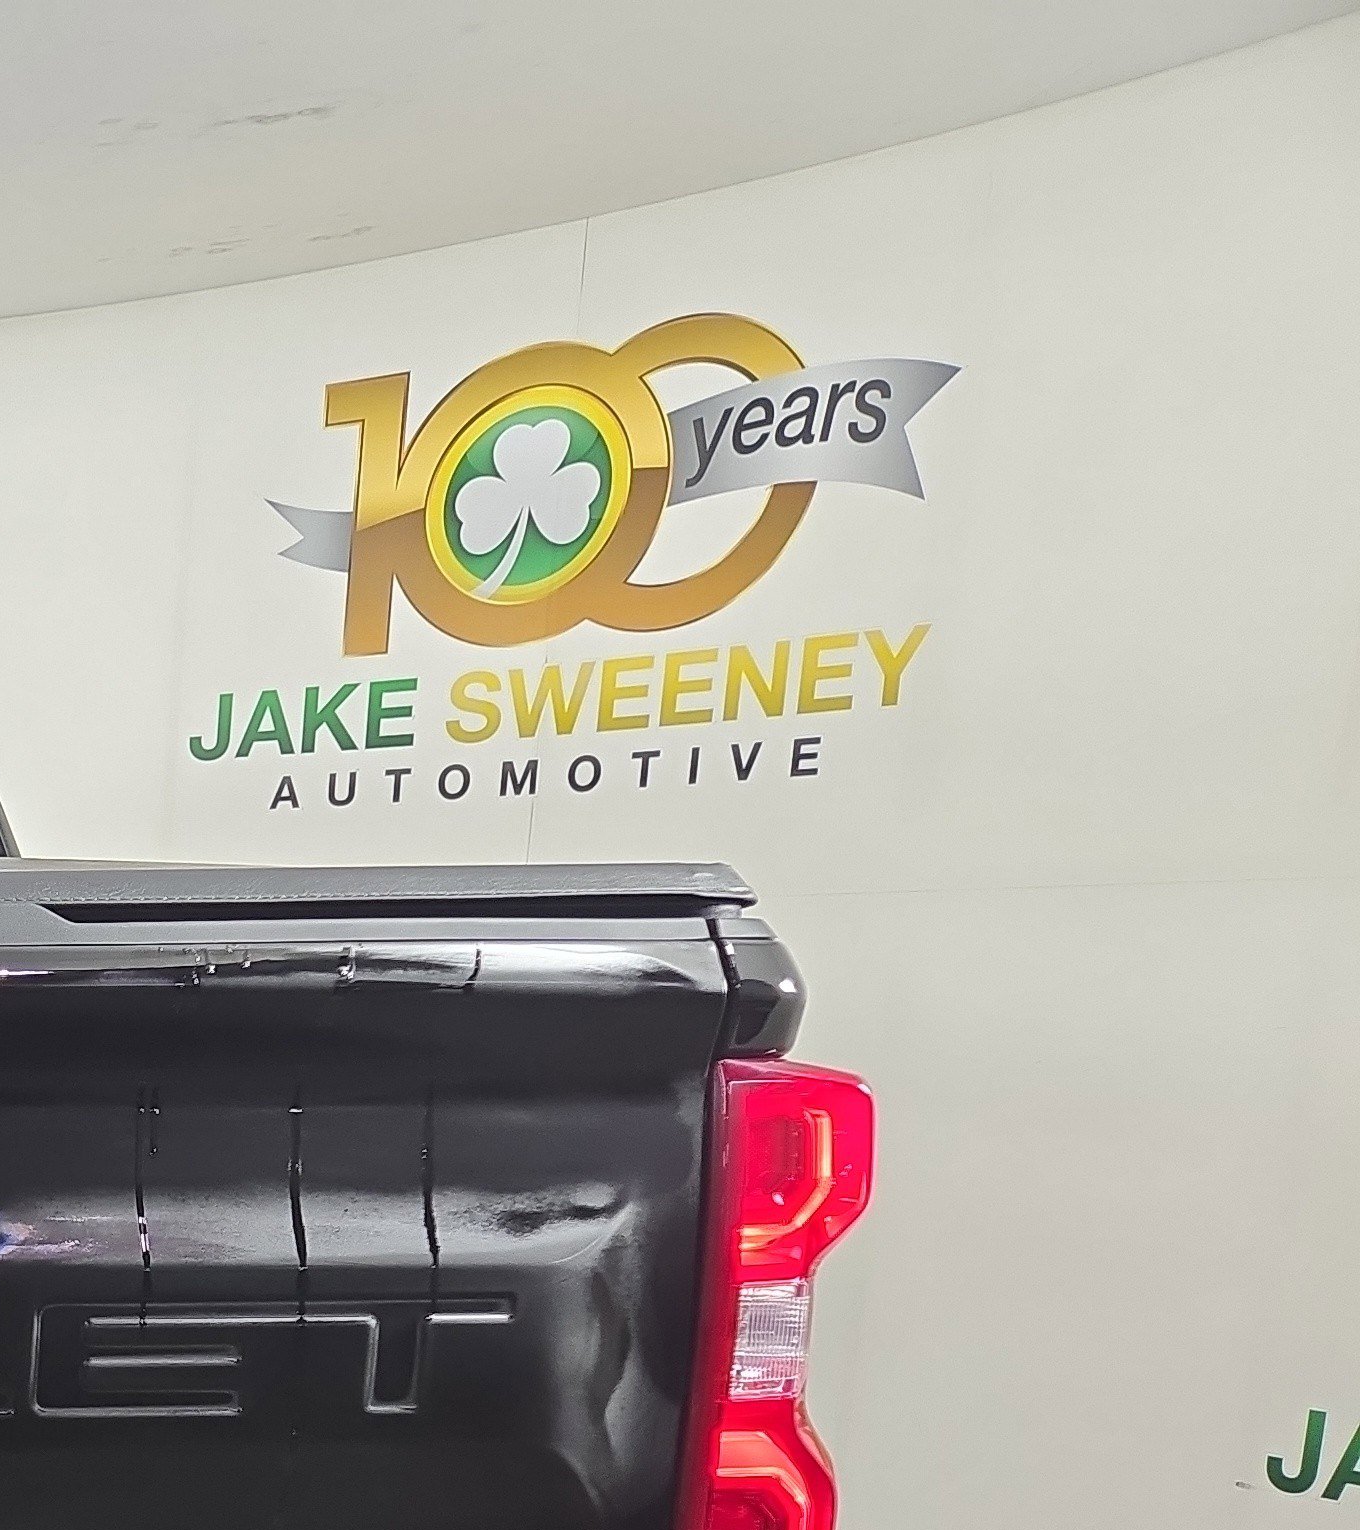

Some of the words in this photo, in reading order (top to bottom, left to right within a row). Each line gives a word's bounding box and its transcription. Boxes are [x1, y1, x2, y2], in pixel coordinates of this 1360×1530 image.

[323, 311, 817, 658] 100
[685, 374, 893, 489] years
[188, 677, 420, 764] JAKE
[444, 622, 933, 745] SWEENEY
[269, 736, 824, 811] AUTOMOTIVE
